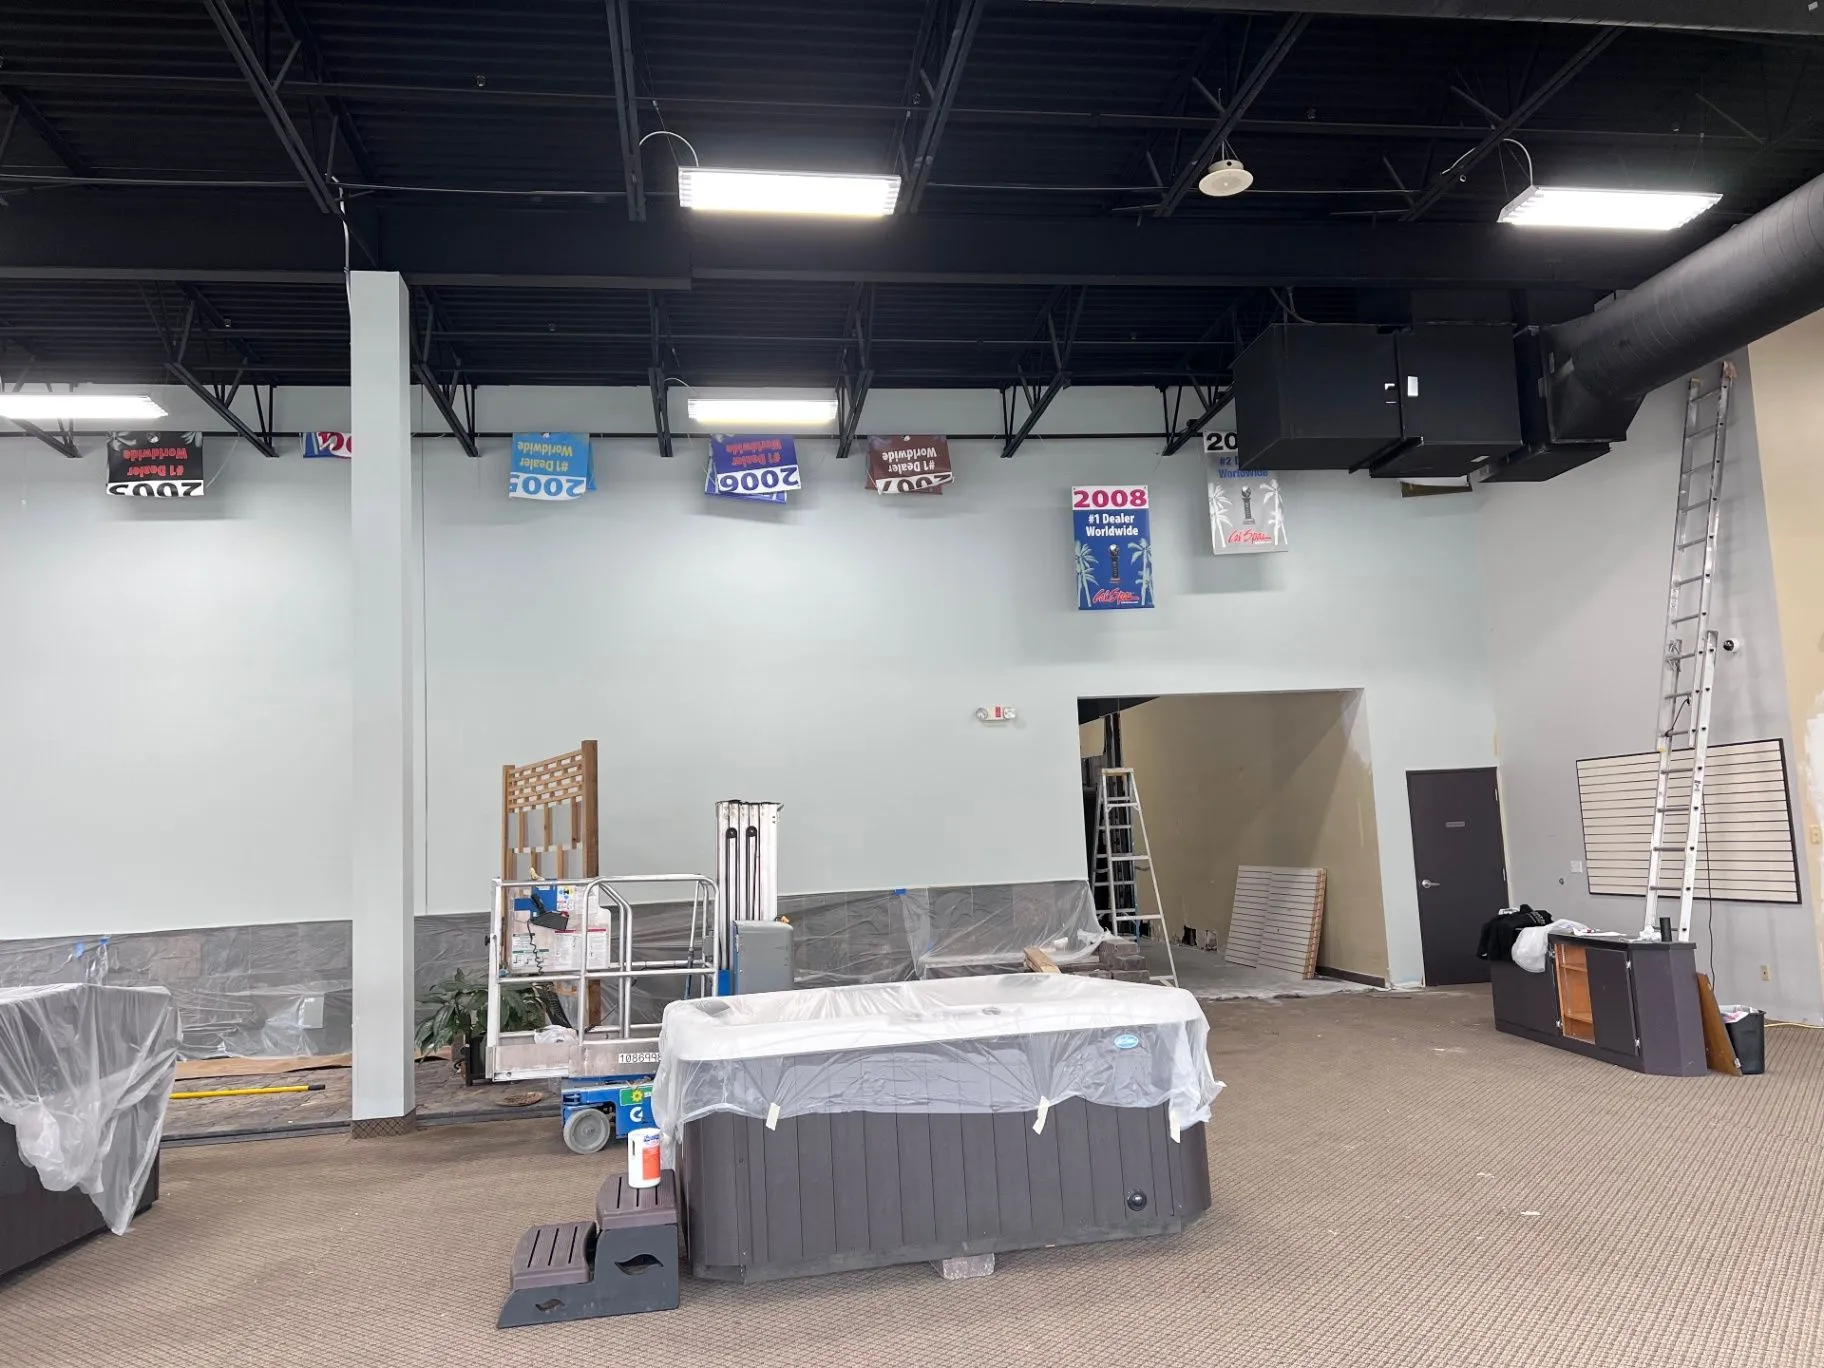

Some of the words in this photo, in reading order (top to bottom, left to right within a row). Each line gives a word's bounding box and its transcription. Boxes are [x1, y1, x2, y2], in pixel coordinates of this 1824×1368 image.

[122, 447, 188, 461] Worldwide
[517, 440, 574, 457] Worldwide
[881, 446, 938, 463] Worldwide
[127, 464, 167, 477] Dealer
[169, 464, 185, 476] #1
[519, 456, 554, 473] Dealer
[556, 460, 569, 472] #1
[888, 461, 921, 475] Dealer
[923, 460, 936, 471] #1
[719, 466, 800, 493] 2006
[1073, 488, 1148, 509] 2008
[1088, 512, 1100, 524] #1
[1102, 512, 1135, 524] Dealer
[1085, 525, 1139, 537] Worldwide
